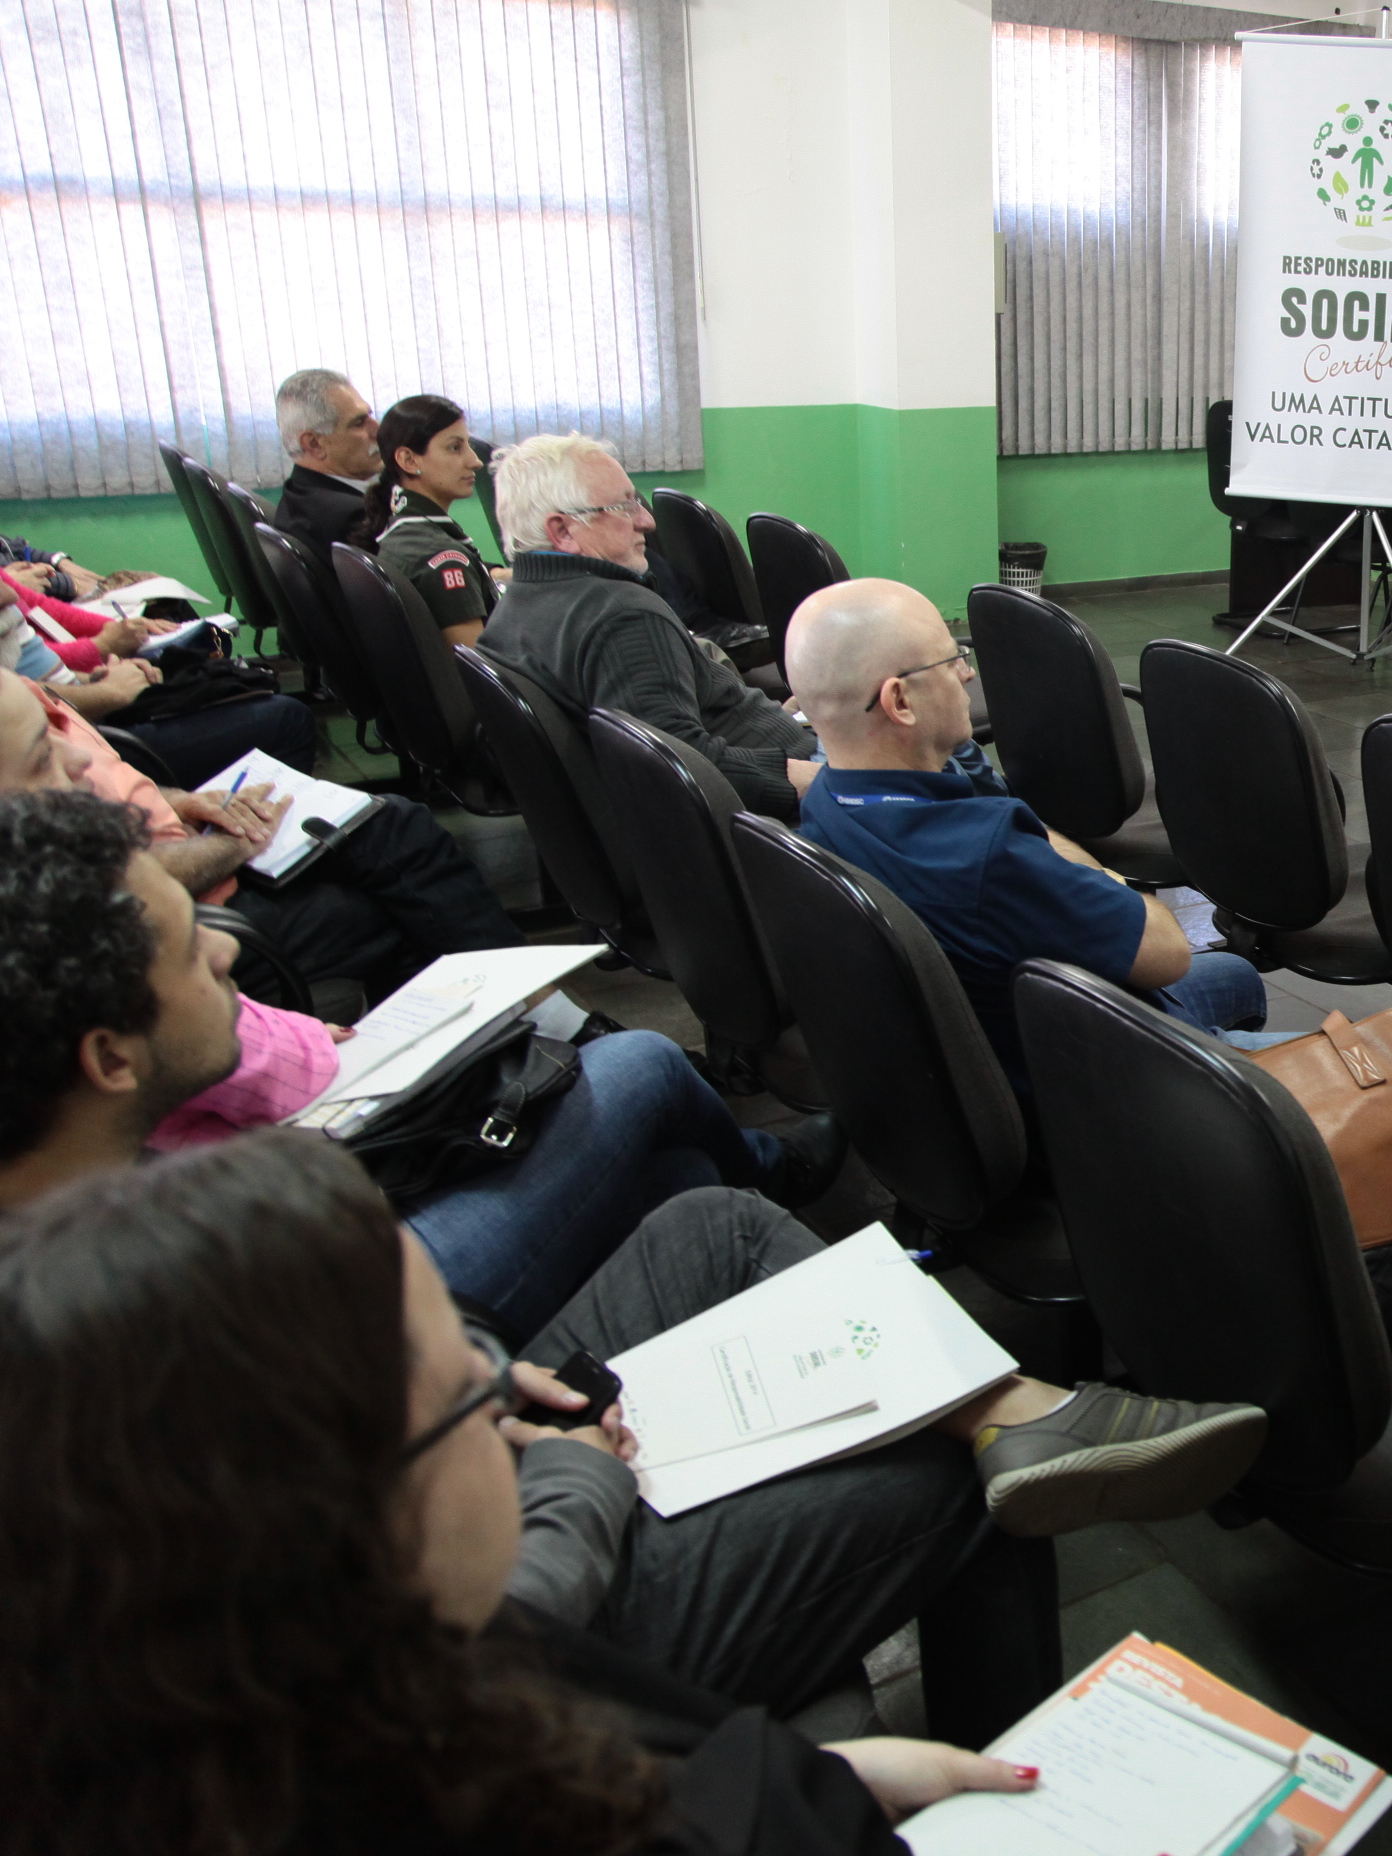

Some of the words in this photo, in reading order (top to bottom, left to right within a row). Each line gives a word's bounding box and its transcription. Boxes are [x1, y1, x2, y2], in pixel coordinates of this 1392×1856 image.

[1271, 391, 1323, 414] UMA
[1245, 421, 1324, 448] VALOR
[444, 570, 466, 588] 86
